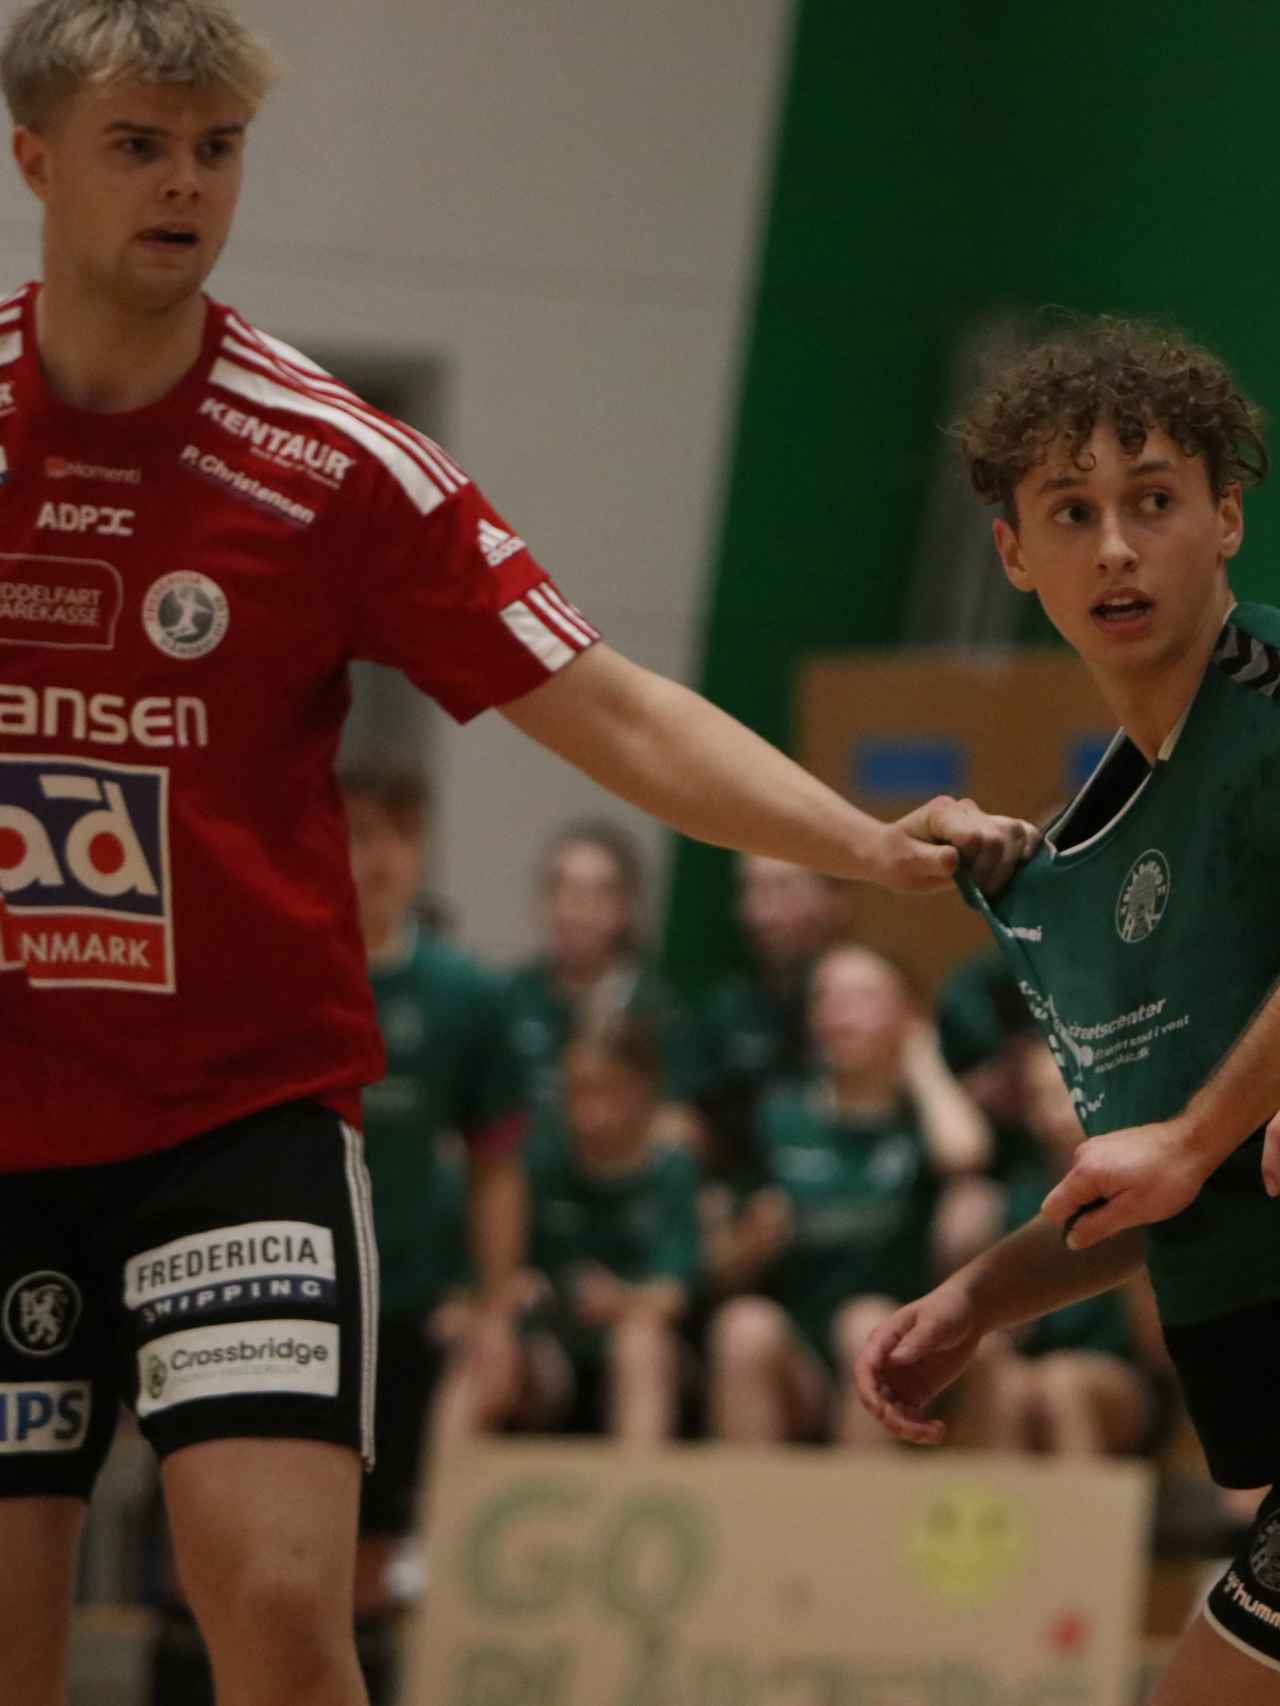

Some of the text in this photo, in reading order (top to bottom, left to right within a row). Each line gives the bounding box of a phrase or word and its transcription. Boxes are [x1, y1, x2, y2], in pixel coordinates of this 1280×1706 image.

[198, 397, 353, 481] KENTAUR
[136, 1235, 318, 1293] FREDERICIA
[144, 1279, 322, 1325] SHIPPING
[170, 1338, 329, 1371] Crossbridge
